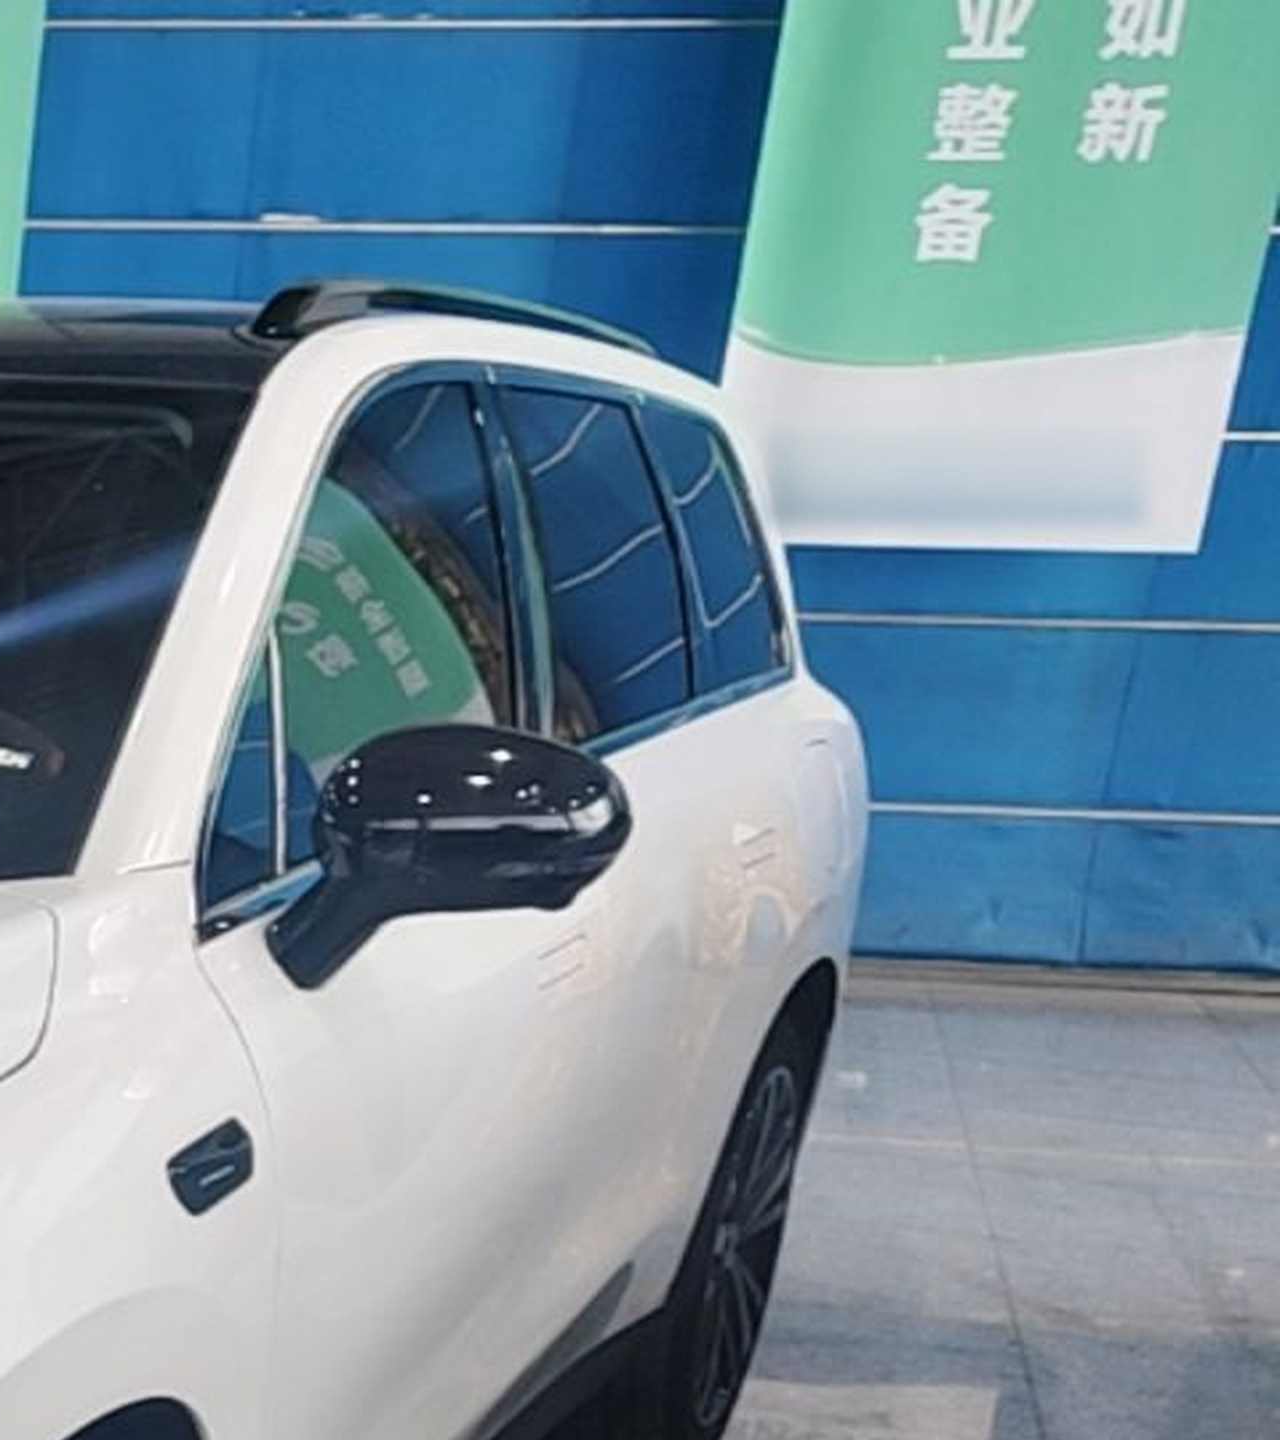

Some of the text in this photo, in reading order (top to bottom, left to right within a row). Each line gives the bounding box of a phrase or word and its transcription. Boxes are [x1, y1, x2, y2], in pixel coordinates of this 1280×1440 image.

[914, 0, 1034, 261] 业整备
[1077, 0, 1187, 161] 如新
